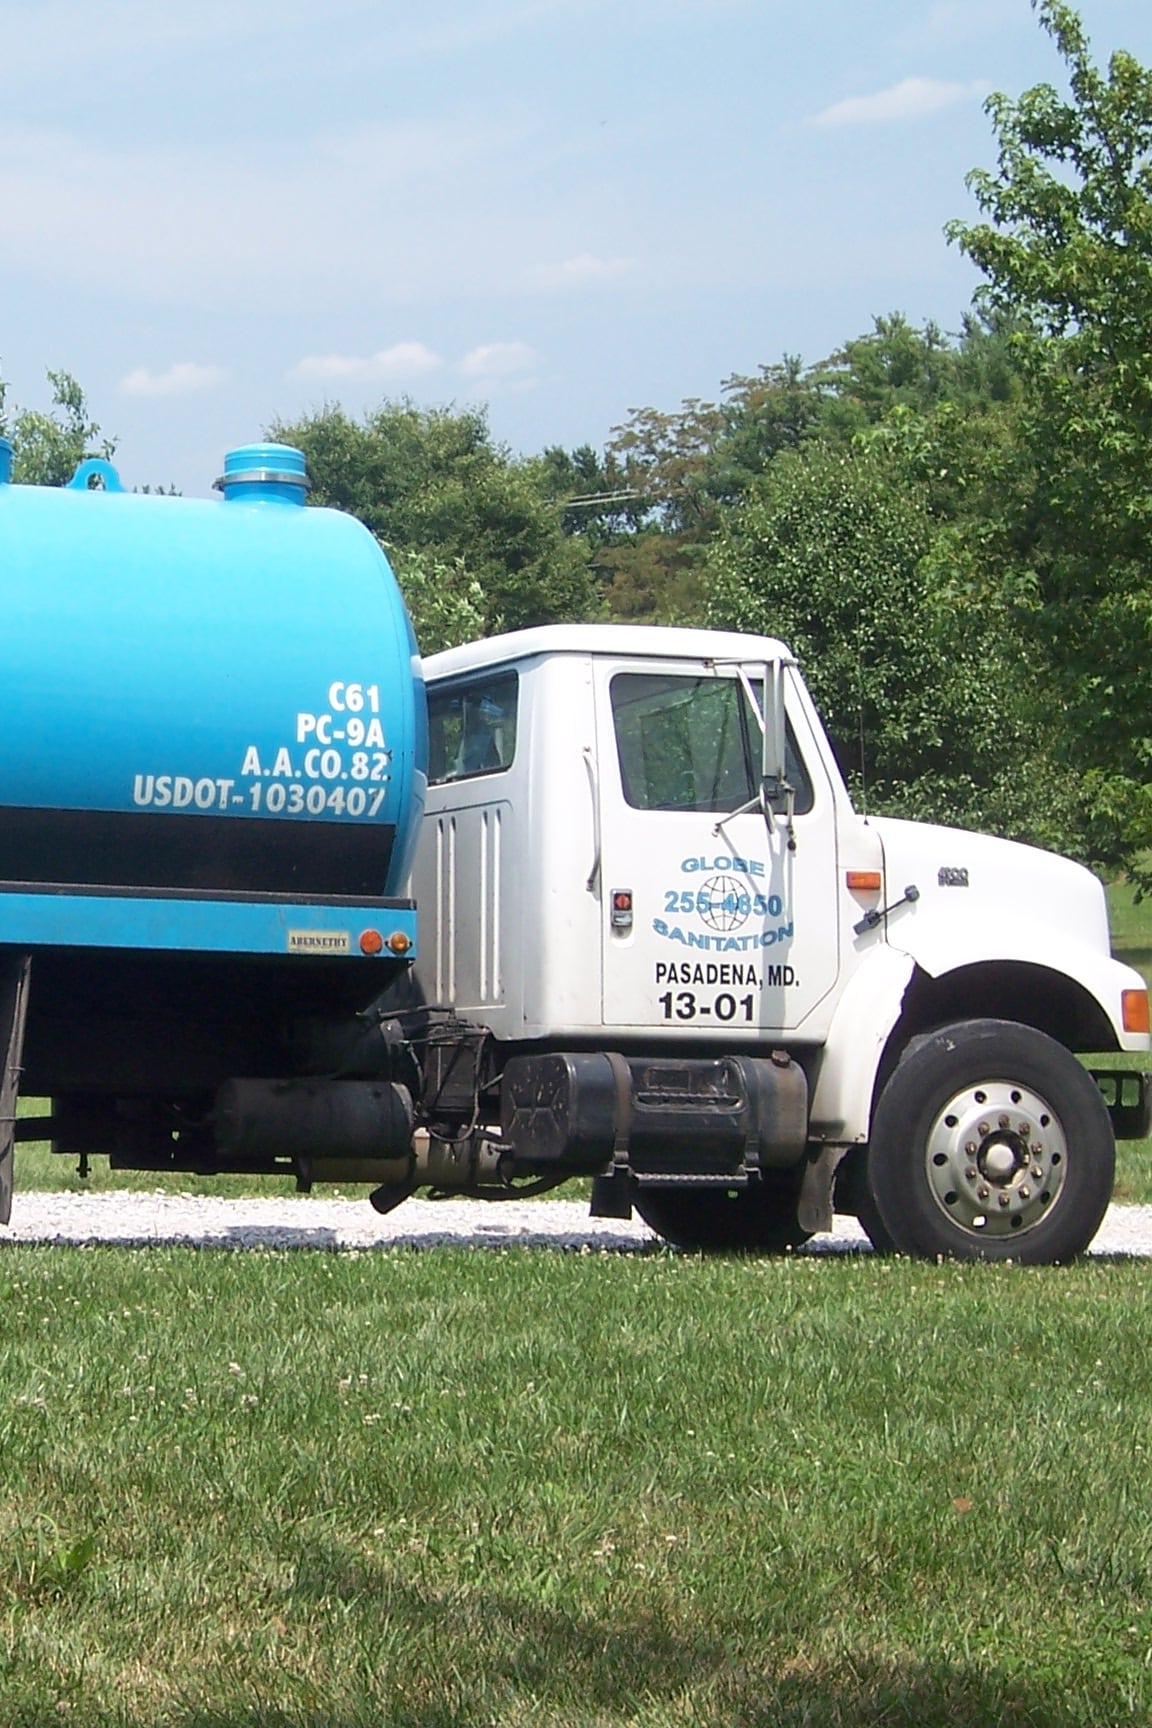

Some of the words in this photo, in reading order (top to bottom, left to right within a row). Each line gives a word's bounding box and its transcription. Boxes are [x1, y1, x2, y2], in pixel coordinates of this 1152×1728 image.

[328, 681, 380, 713] C61
[297, 713, 385, 748] PC-9A
[134, 774, 386, 816] USDOT-1030407
[680, 856, 765, 877] GLOBE
[664, 890, 783, 917] 255-4650
[290, 935, 347, 947] ABERNETHY
[652, 918, 794, 952] SANITATION
[656, 963, 764, 990] PASADENA,
[768, 965, 800, 987] MD.
[659, 992, 754, 1021] 13-01
